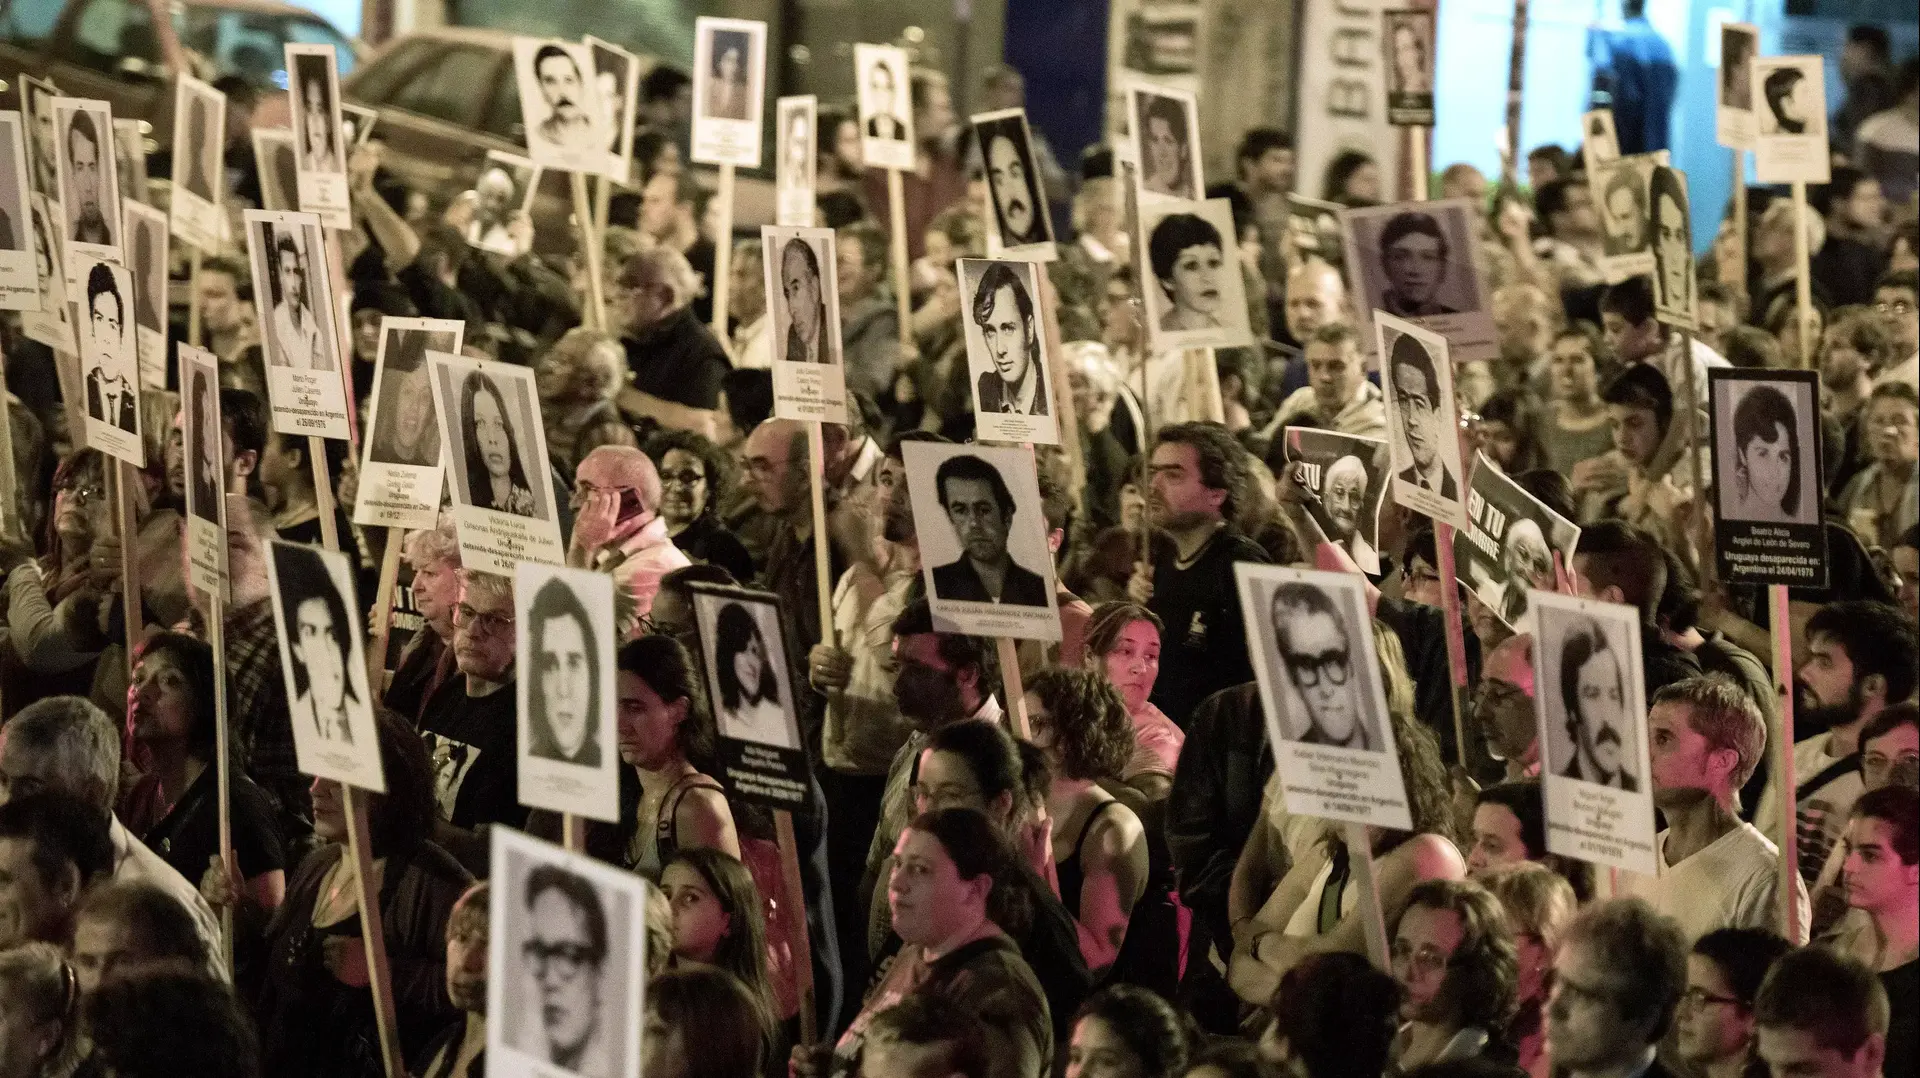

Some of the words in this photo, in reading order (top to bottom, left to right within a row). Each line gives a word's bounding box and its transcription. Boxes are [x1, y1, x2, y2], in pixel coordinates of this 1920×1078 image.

[488, 515, 509, 527] Victoria
[1484, 502, 1506, 541] TU
[1751, 526, 1772, 537] Beatriz
[1773, 528, 1790, 537] Alicia
[497, 539, 524, 552] Uruguaya
[1753, 538, 1761, 546] de
[1779, 539, 1787, 547] de
[1788, 539, 1810, 550] Severo
[1724, 550, 1759, 564] Uruguaya
[1760, 553, 1808, 566] desaparecida
[1732, 563, 1767, 575] Argentina
[1768, 565, 1775, 575] el
[936, 605, 961, 613] CARLOS
